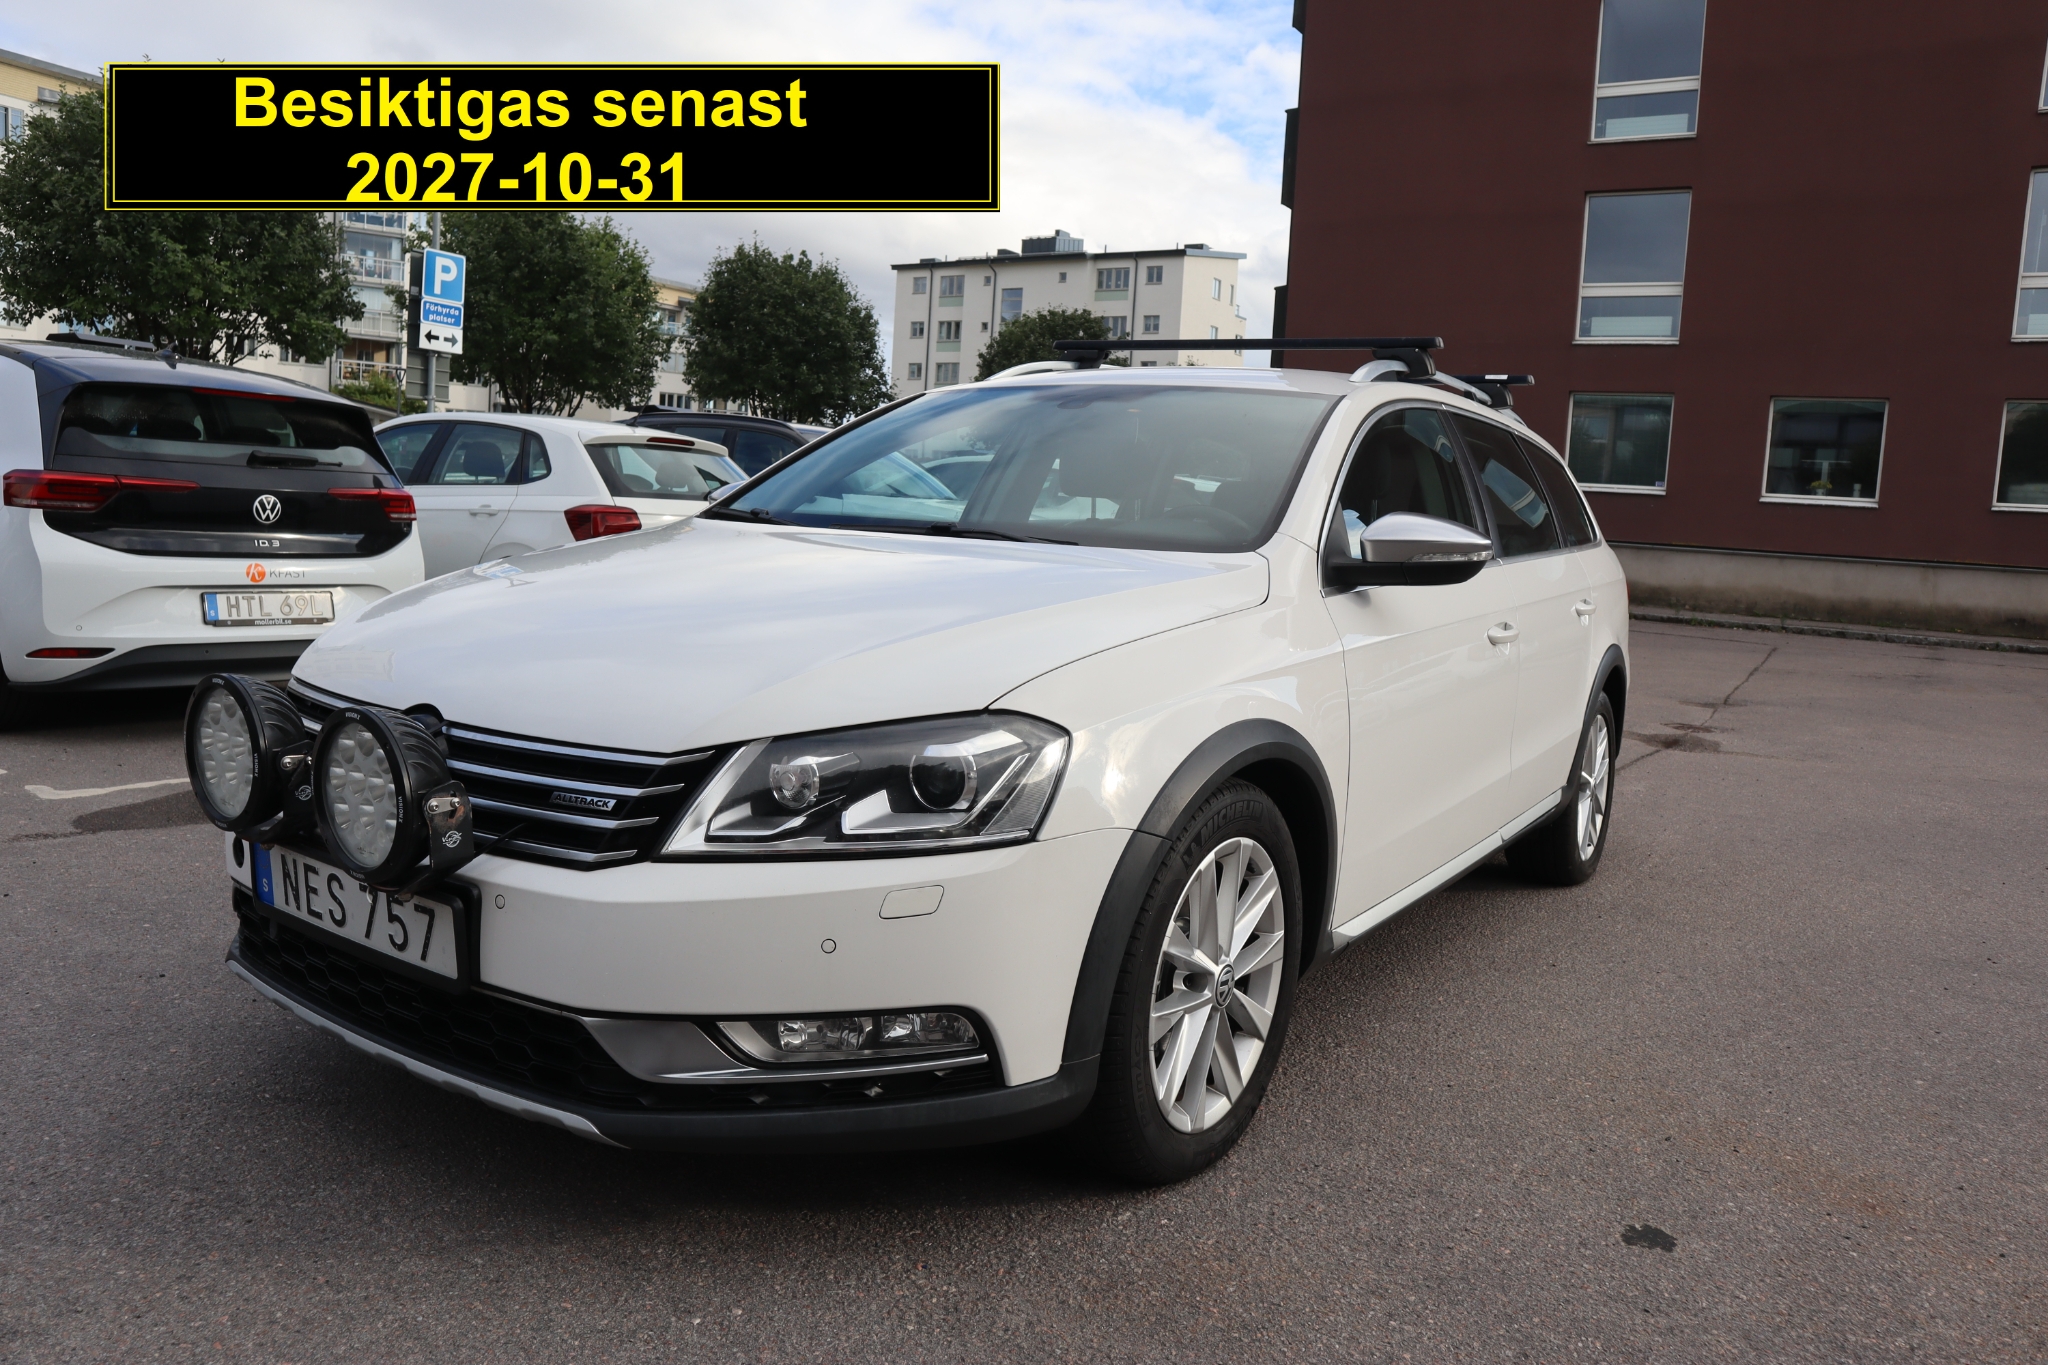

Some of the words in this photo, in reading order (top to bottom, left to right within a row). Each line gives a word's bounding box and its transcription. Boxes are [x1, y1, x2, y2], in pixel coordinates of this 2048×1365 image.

[433, 256, 458, 295] P
[425, 303, 460, 316] Förhyrda
[428, 313, 456, 325] platser
[226, 595, 273, 617] HTL
[280, 595, 324, 616] 69L
[553, 793, 611, 809] ALLTRACK
[1200, 799, 1264, 846] MICHELIN
[262, 877, 270, 893] S
[280, 853, 347, 928] NES
[358, 882, 436, 962] 757
